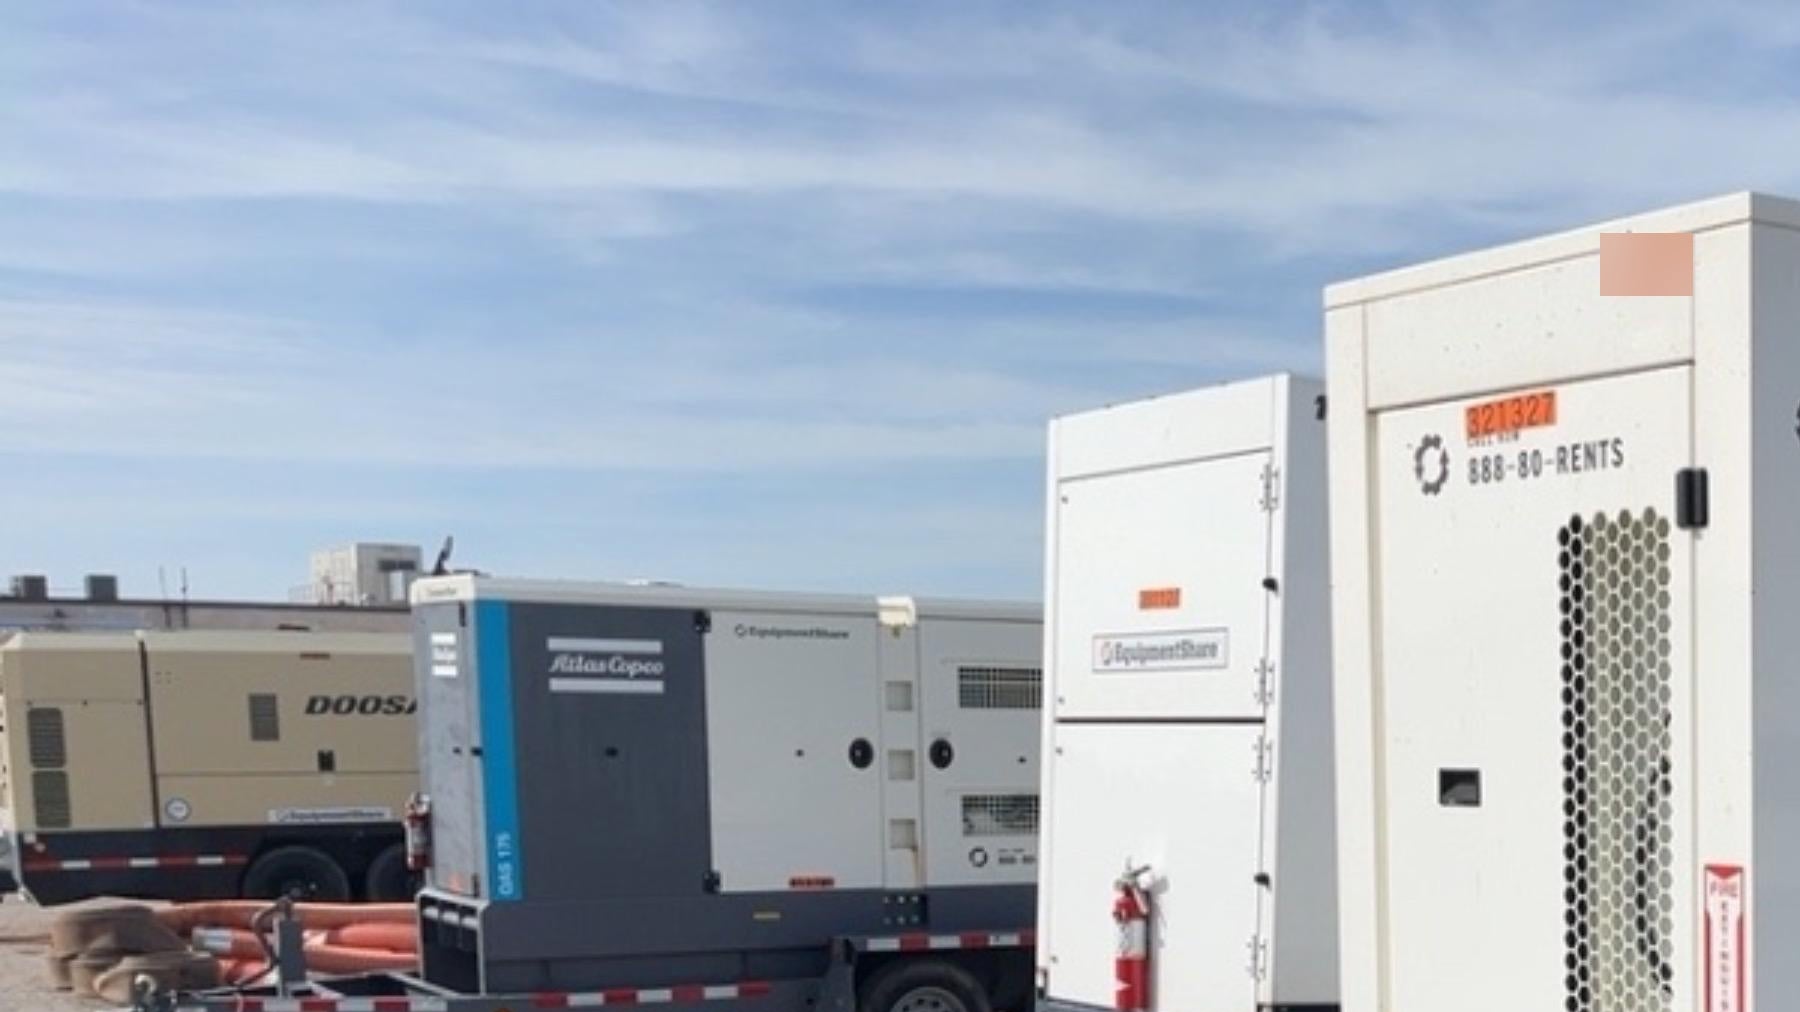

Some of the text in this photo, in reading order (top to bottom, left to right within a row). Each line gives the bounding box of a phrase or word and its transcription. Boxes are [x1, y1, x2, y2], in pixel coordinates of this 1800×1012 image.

[1467, 390, 1555, 438] 321327
[1468, 437, 1624, 484] 888-80-RENTS
[549, 653, 664, 678] Atlas Copco
[1115, 639, 1218, 665] EquipmentShare
